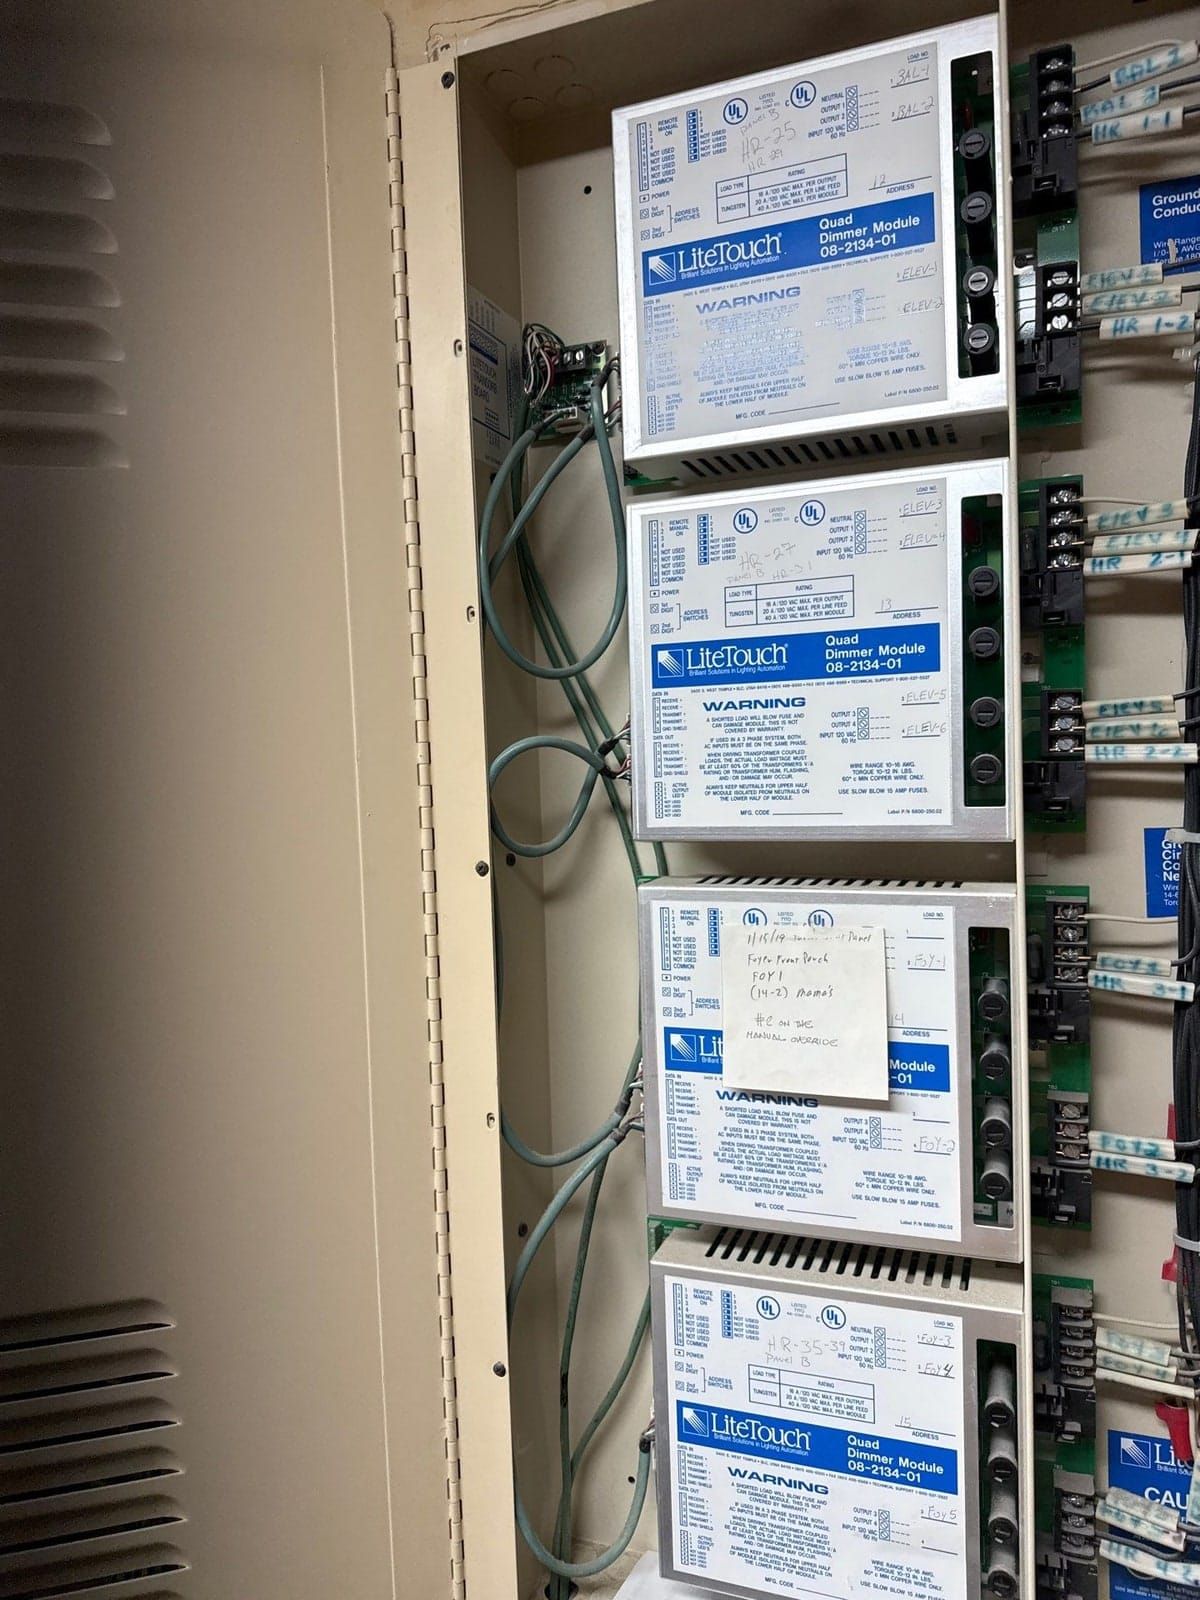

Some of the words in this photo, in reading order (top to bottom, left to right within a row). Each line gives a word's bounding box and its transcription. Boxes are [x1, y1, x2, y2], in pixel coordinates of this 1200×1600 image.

[886, 182, 914, 194] ADDRESS
[819, 213, 852, 230] Quad
[819, 224, 867, 244] Dimmer
[872, 213, 920, 233] Module
[677, 230, 781, 273] LiteTouch
[820, 232, 896, 258] 08-2134-01
[695, 285, 800, 315] WARNING
[1091, 557, 1122, 574] HR
[892, 611, 920, 619] ADDRESS
[825, 633, 858, 646] Quad
[686, 641, 787, 669] LiteTouch
[825, 646, 873, 659] Dimmer
[878, 642, 925, 656] Module
[737, 665, 755, 674] Lighting
[826, 657, 902, 673] 08-2134-01
[702, 696, 806, 711] WARNING
[746, 1031, 787, 1042] MANUAL
[790, 1036, 839, 1048] OVERRIDE
[901, 1029, 929, 1037] ADDRESS
[888, 1059, 934, 1072] Module
[715, 1090, 818, 1108] WARNING
[711, 1412, 810, 1450] LiteTouch
[911, 1430, 938, 1440] ADDRESS
[847, 1434, 879, 1450] Quad
[847, 1447, 893, 1465] Dimmer
[898, 1456, 943, 1474] Module
[847, 1459, 921, 1483] 08-2134-01
[727, 1466, 828, 1495] WARNING
